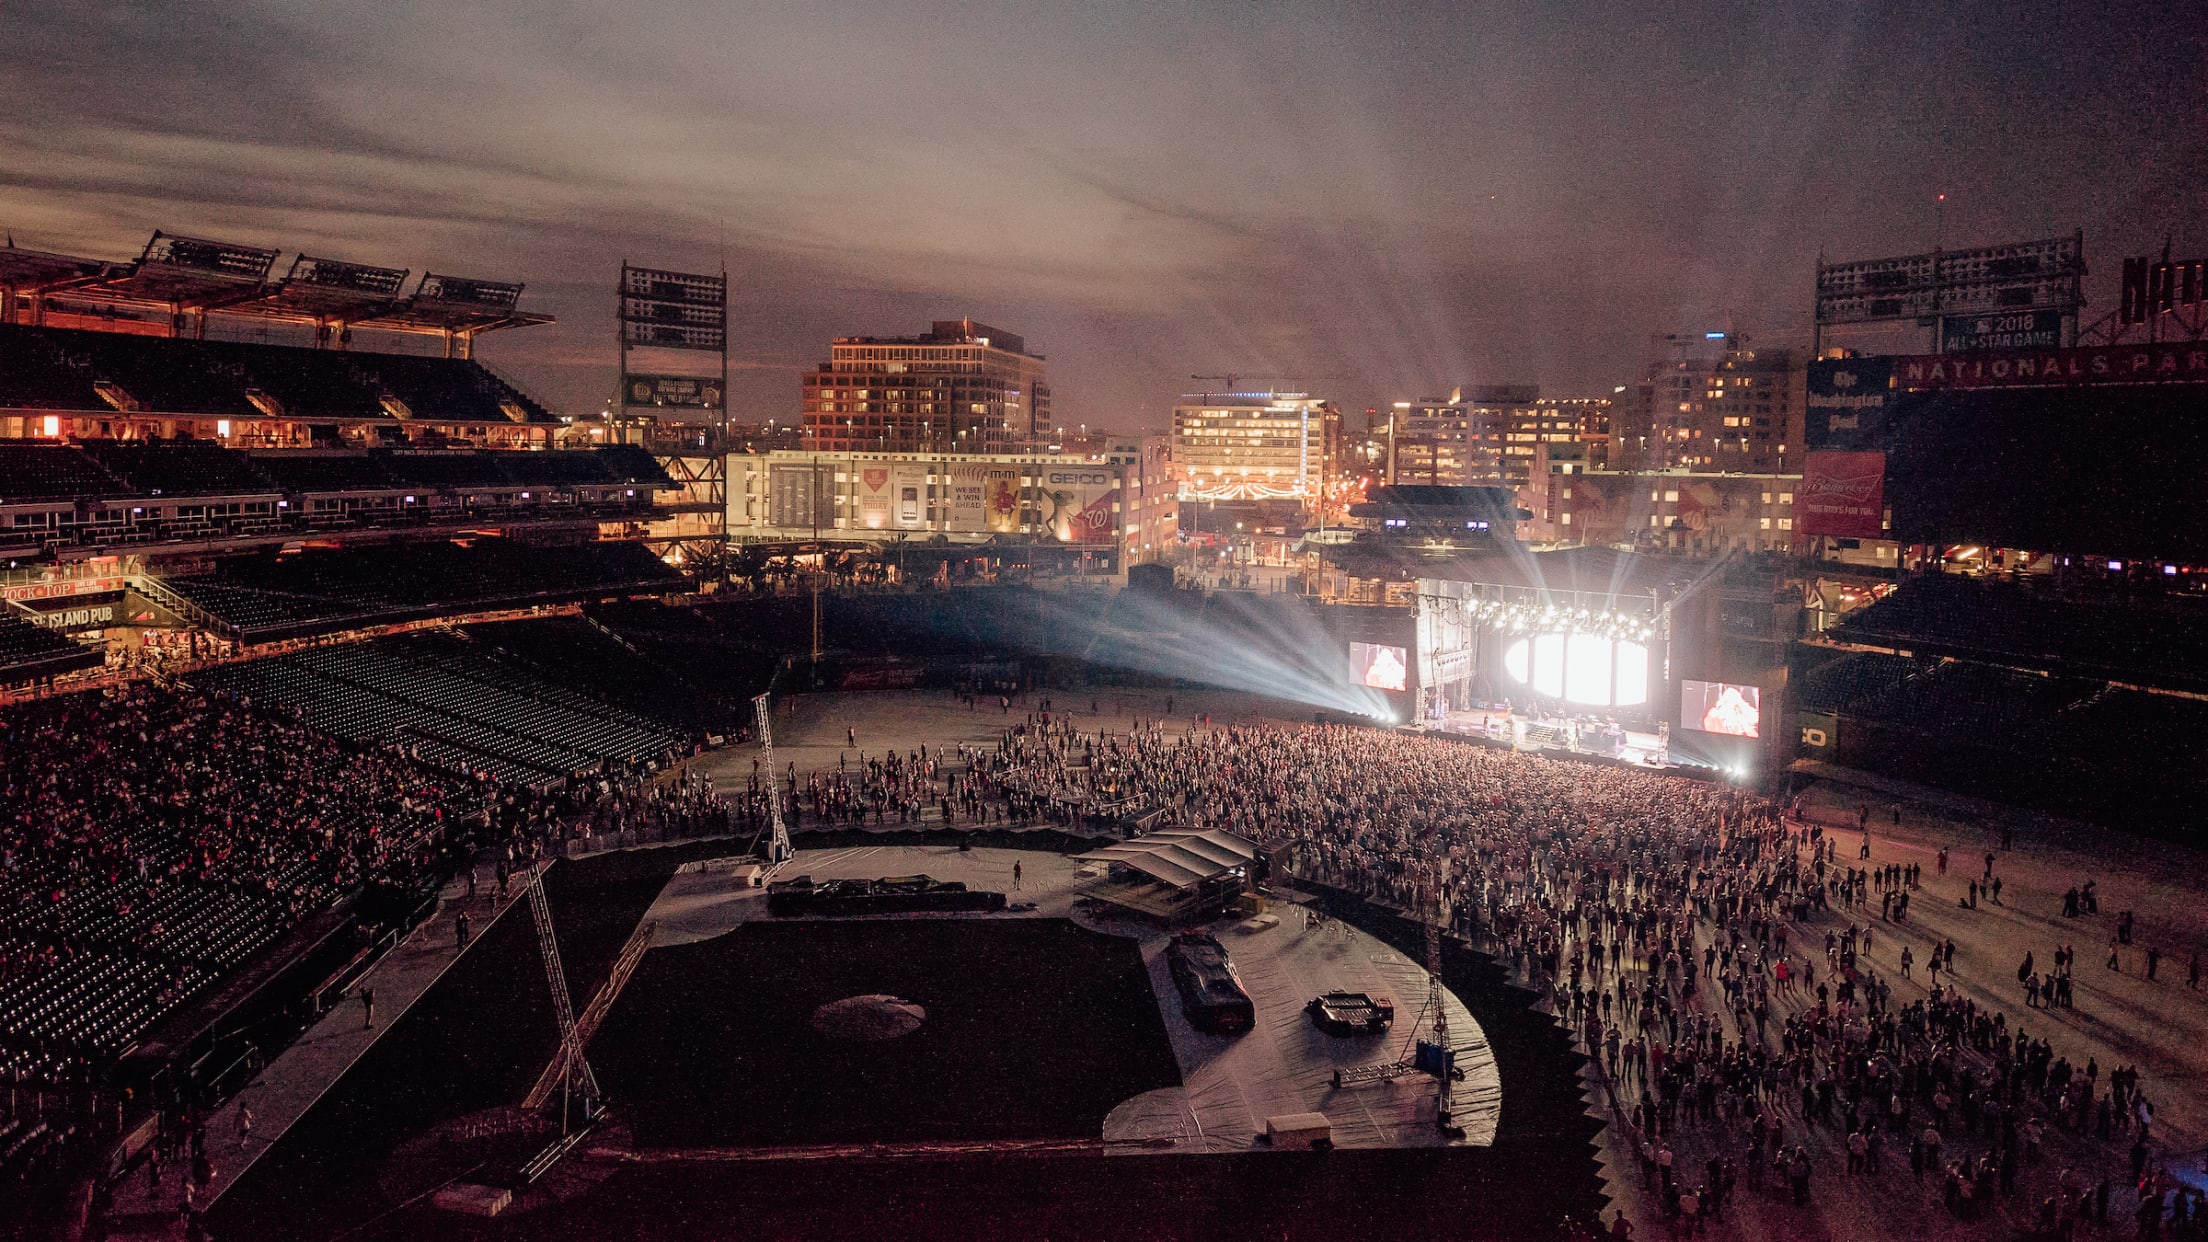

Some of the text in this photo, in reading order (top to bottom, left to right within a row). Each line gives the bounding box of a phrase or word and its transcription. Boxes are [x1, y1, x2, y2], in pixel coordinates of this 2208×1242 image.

[1996, 315, 2033, 332] 2018
[2014, 331, 2054, 347] GAME
[1908, 354, 2108, 380] NATIONALS
[1049, 473, 1106, 485] GEICO
[955, 501, 981, 509] AHEAD
[43, 584, 70, 597] TOP
[48, 610, 89, 628] ISLAND
[90, 607, 112, 622] PUB
